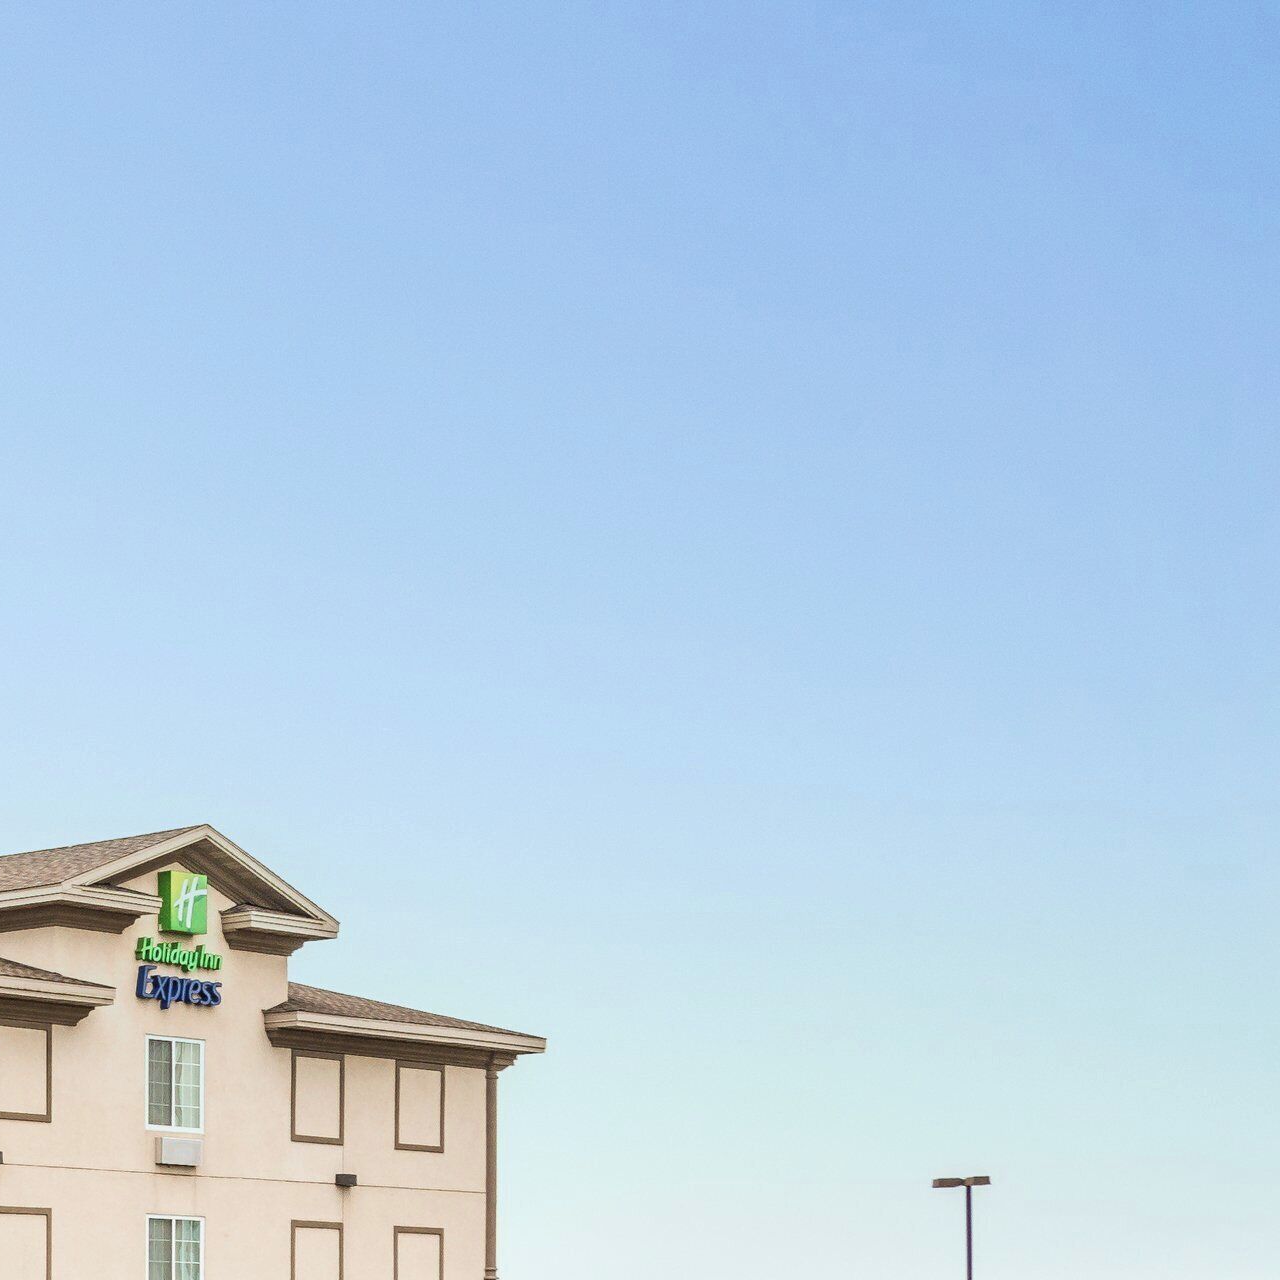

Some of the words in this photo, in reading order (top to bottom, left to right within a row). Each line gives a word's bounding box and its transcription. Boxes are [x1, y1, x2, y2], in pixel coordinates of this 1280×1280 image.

[136, 937, 198, 974] Holiday
[197, 944, 223, 970] Inn
[136, 965, 223, 1010] Express
